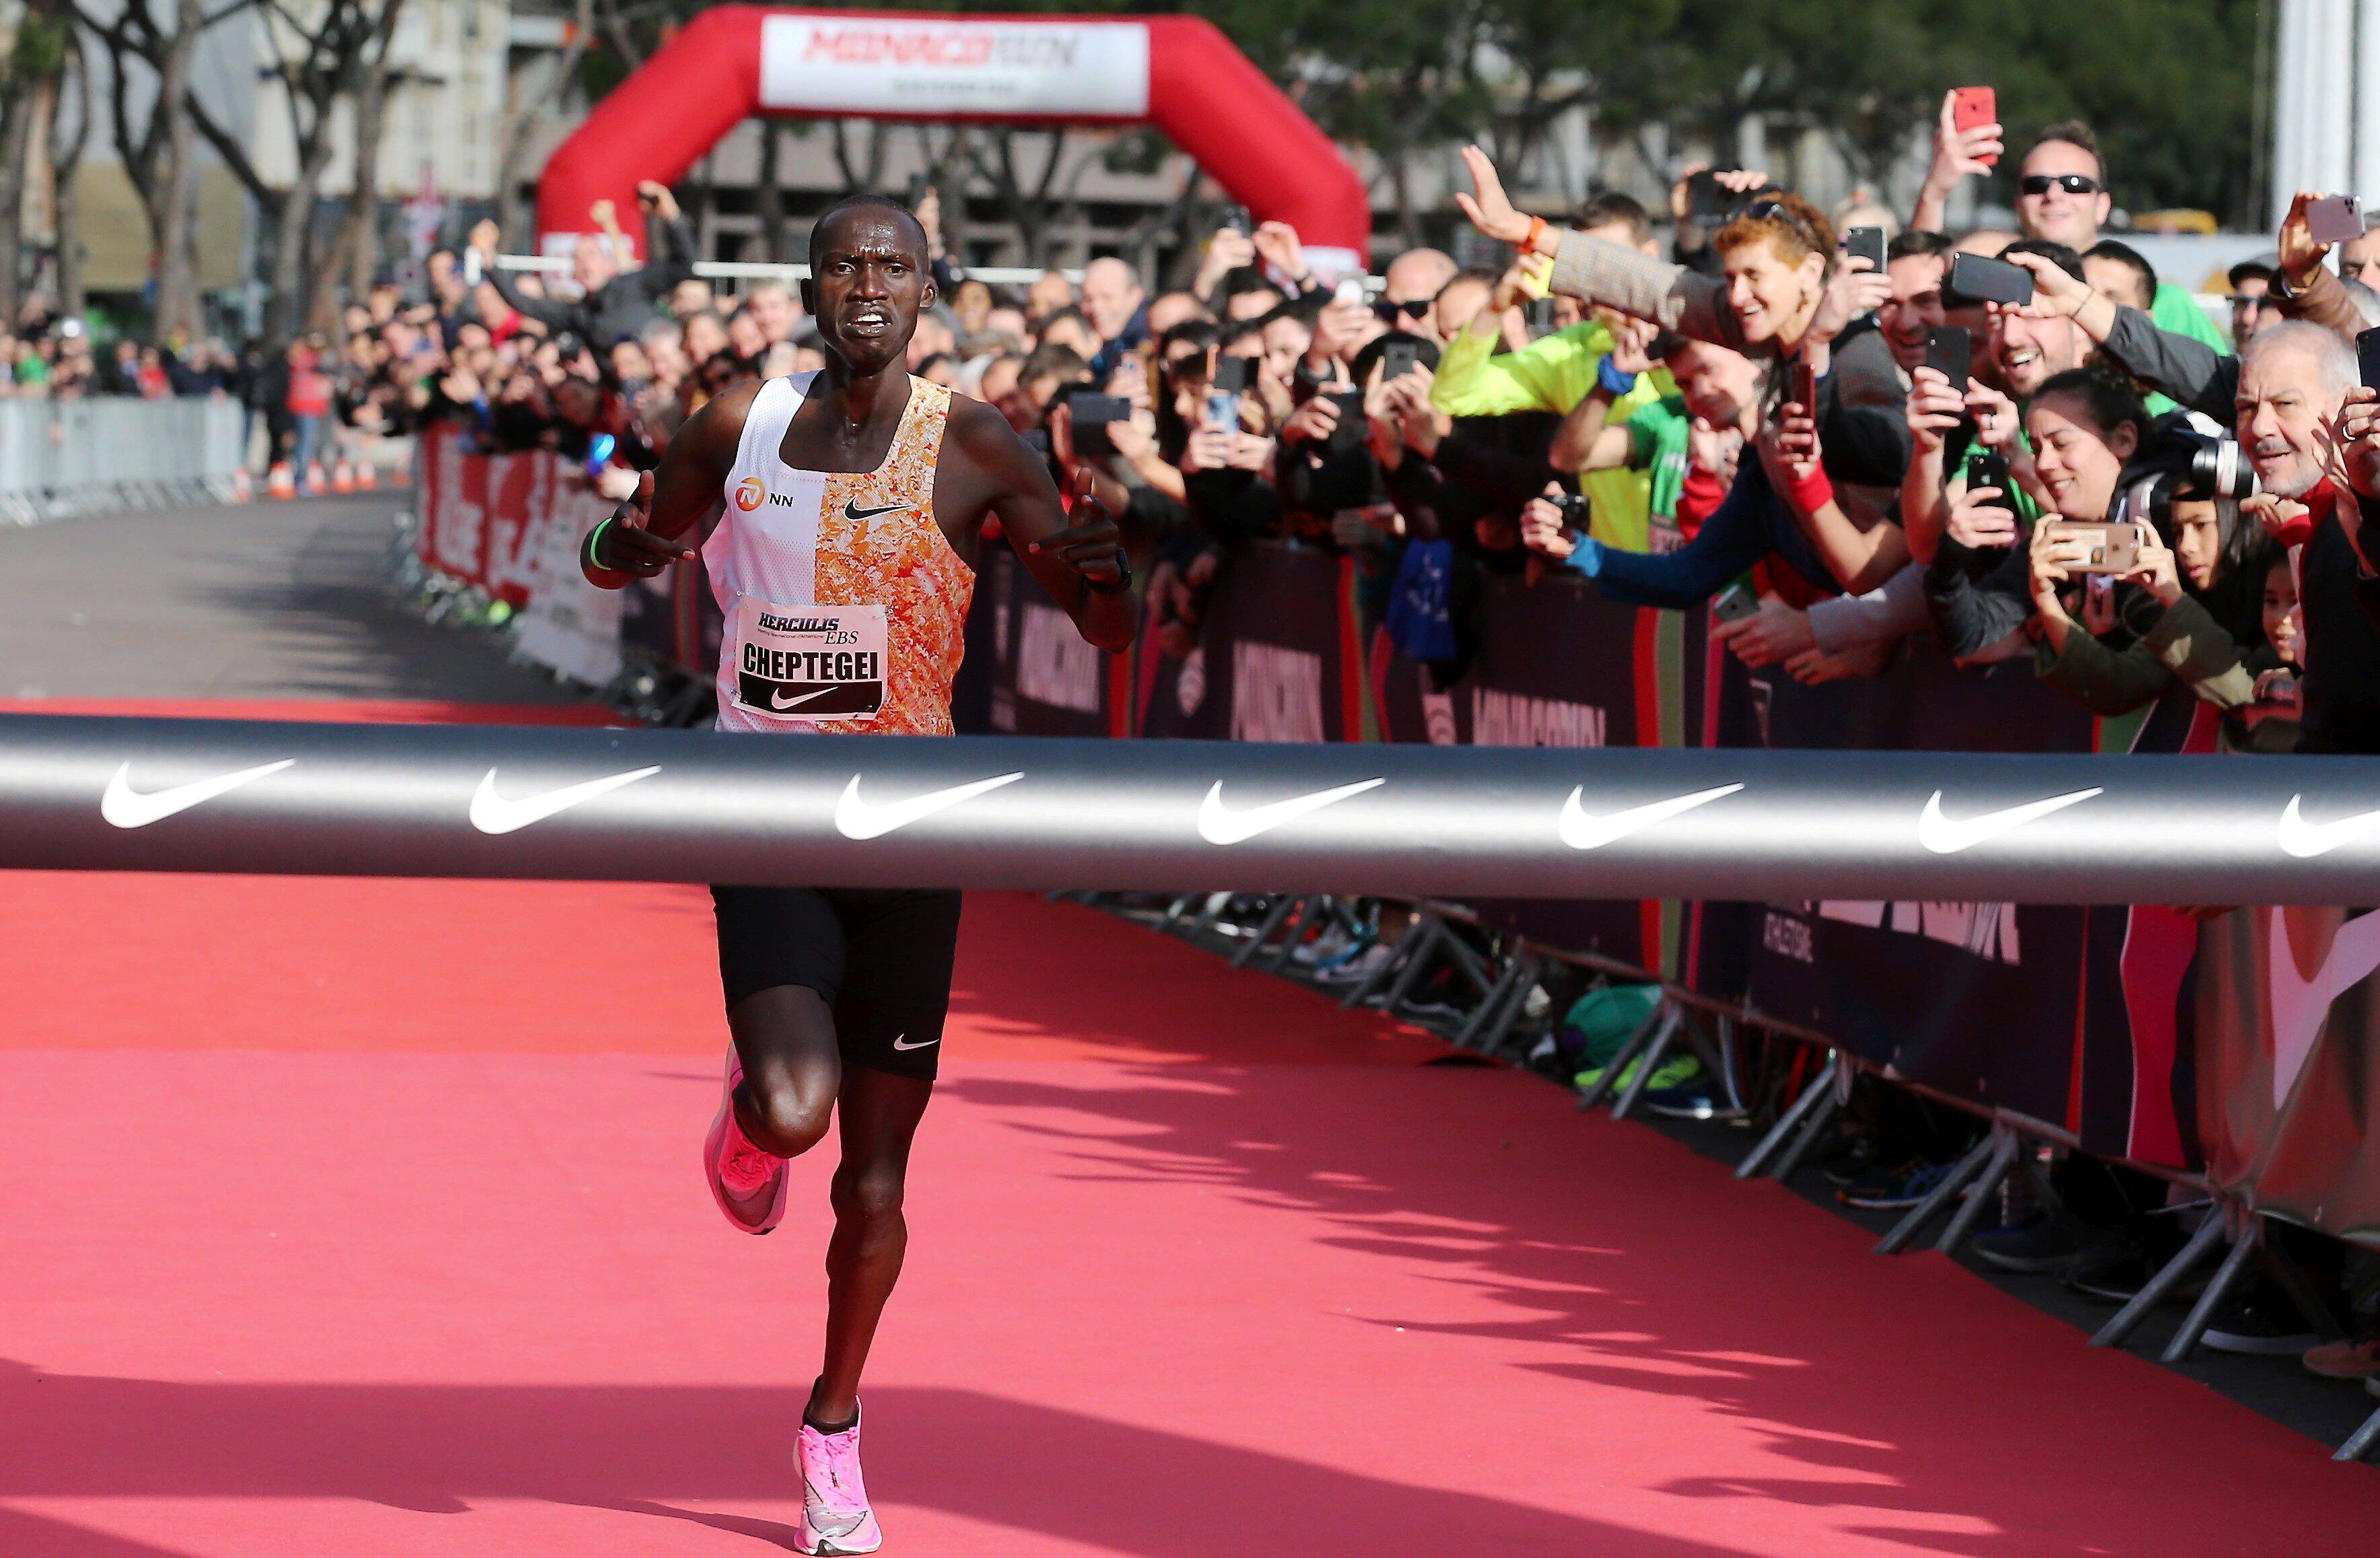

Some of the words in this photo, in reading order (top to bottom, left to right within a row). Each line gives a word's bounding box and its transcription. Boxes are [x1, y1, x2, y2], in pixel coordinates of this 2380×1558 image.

[769, 492, 794, 508] NN
[758, 611, 840, 632] HERCULIS
[824, 630, 859, 644] EBS
[743, 642, 878, 680] CHEPTEGEI
